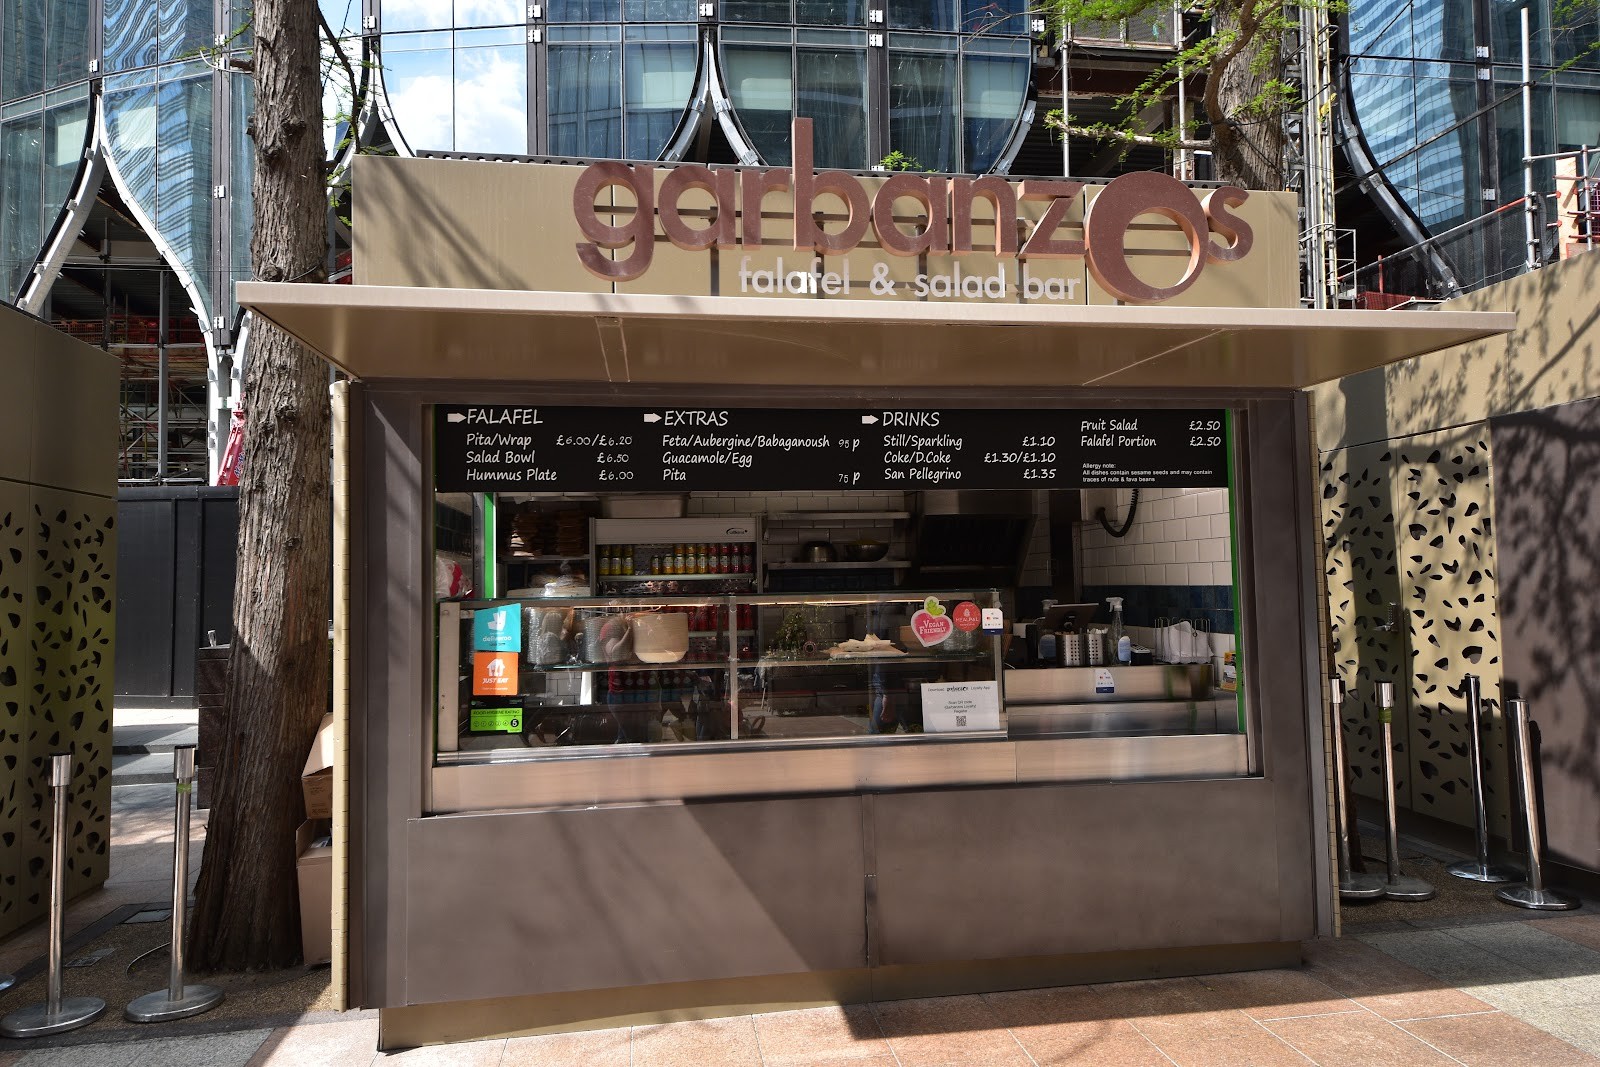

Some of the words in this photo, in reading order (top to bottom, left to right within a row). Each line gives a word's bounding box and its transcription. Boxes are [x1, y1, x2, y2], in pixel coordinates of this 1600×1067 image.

[739, 256, 850, 296] falafel
[870, 263, 897, 297] &
[914, 267, 1005, 299] salad
[1023, 263, 1081, 301] bar
[466, 408, 543, 425] FALAFEL
[664, 410, 729, 426] EXTRAS
[882, 411, 940, 427] DRINKS
[1081, 419, 1107, 432] Fruit
[1110, 418, 1138, 431] Salad
[1189, 420, 1221, 431] £2.50
[466, 432, 532, 450] Pita/Wrap
[556, 434, 633, 447] £6.00/£6.20
[662, 433, 830, 450] Feta/Aubergine/Babaganoush
[852, 438, 860, 452] p
[883, 434, 963, 450] Still/Sparkling
[1022, 435, 1056, 447] £1.10
[1081, 436, 1115, 448] Falafel
[1117, 435, 1157, 447] Portion
[1189, 436, 1222, 447] £2.50
[466, 449, 502, 464] Salad
[505, 450, 535, 464] Bowl
[597, 452, 630, 463] £6.50
[662, 450, 753, 468] Guacamole/Egg
[884, 450, 951, 464] Coke/D.Coke
[984, 451, 1056, 464] £1.30/£1.10
[466, 468, 523, 481] Hummus
[526, 468, 557, 481] Plate
[599, 469, 634, 481] £6.00
[662, 467, 687, 481] Pita
[852, 471, 861, 485] p
[884, 467, 906, 480] San
[908, 468, 962, 484] Pellegrino
[1023, 469, 1056, 480] £1.35
[919, 625, 947, 635] FRIENDLY
[923, 619, 945, 629] VEGAN
